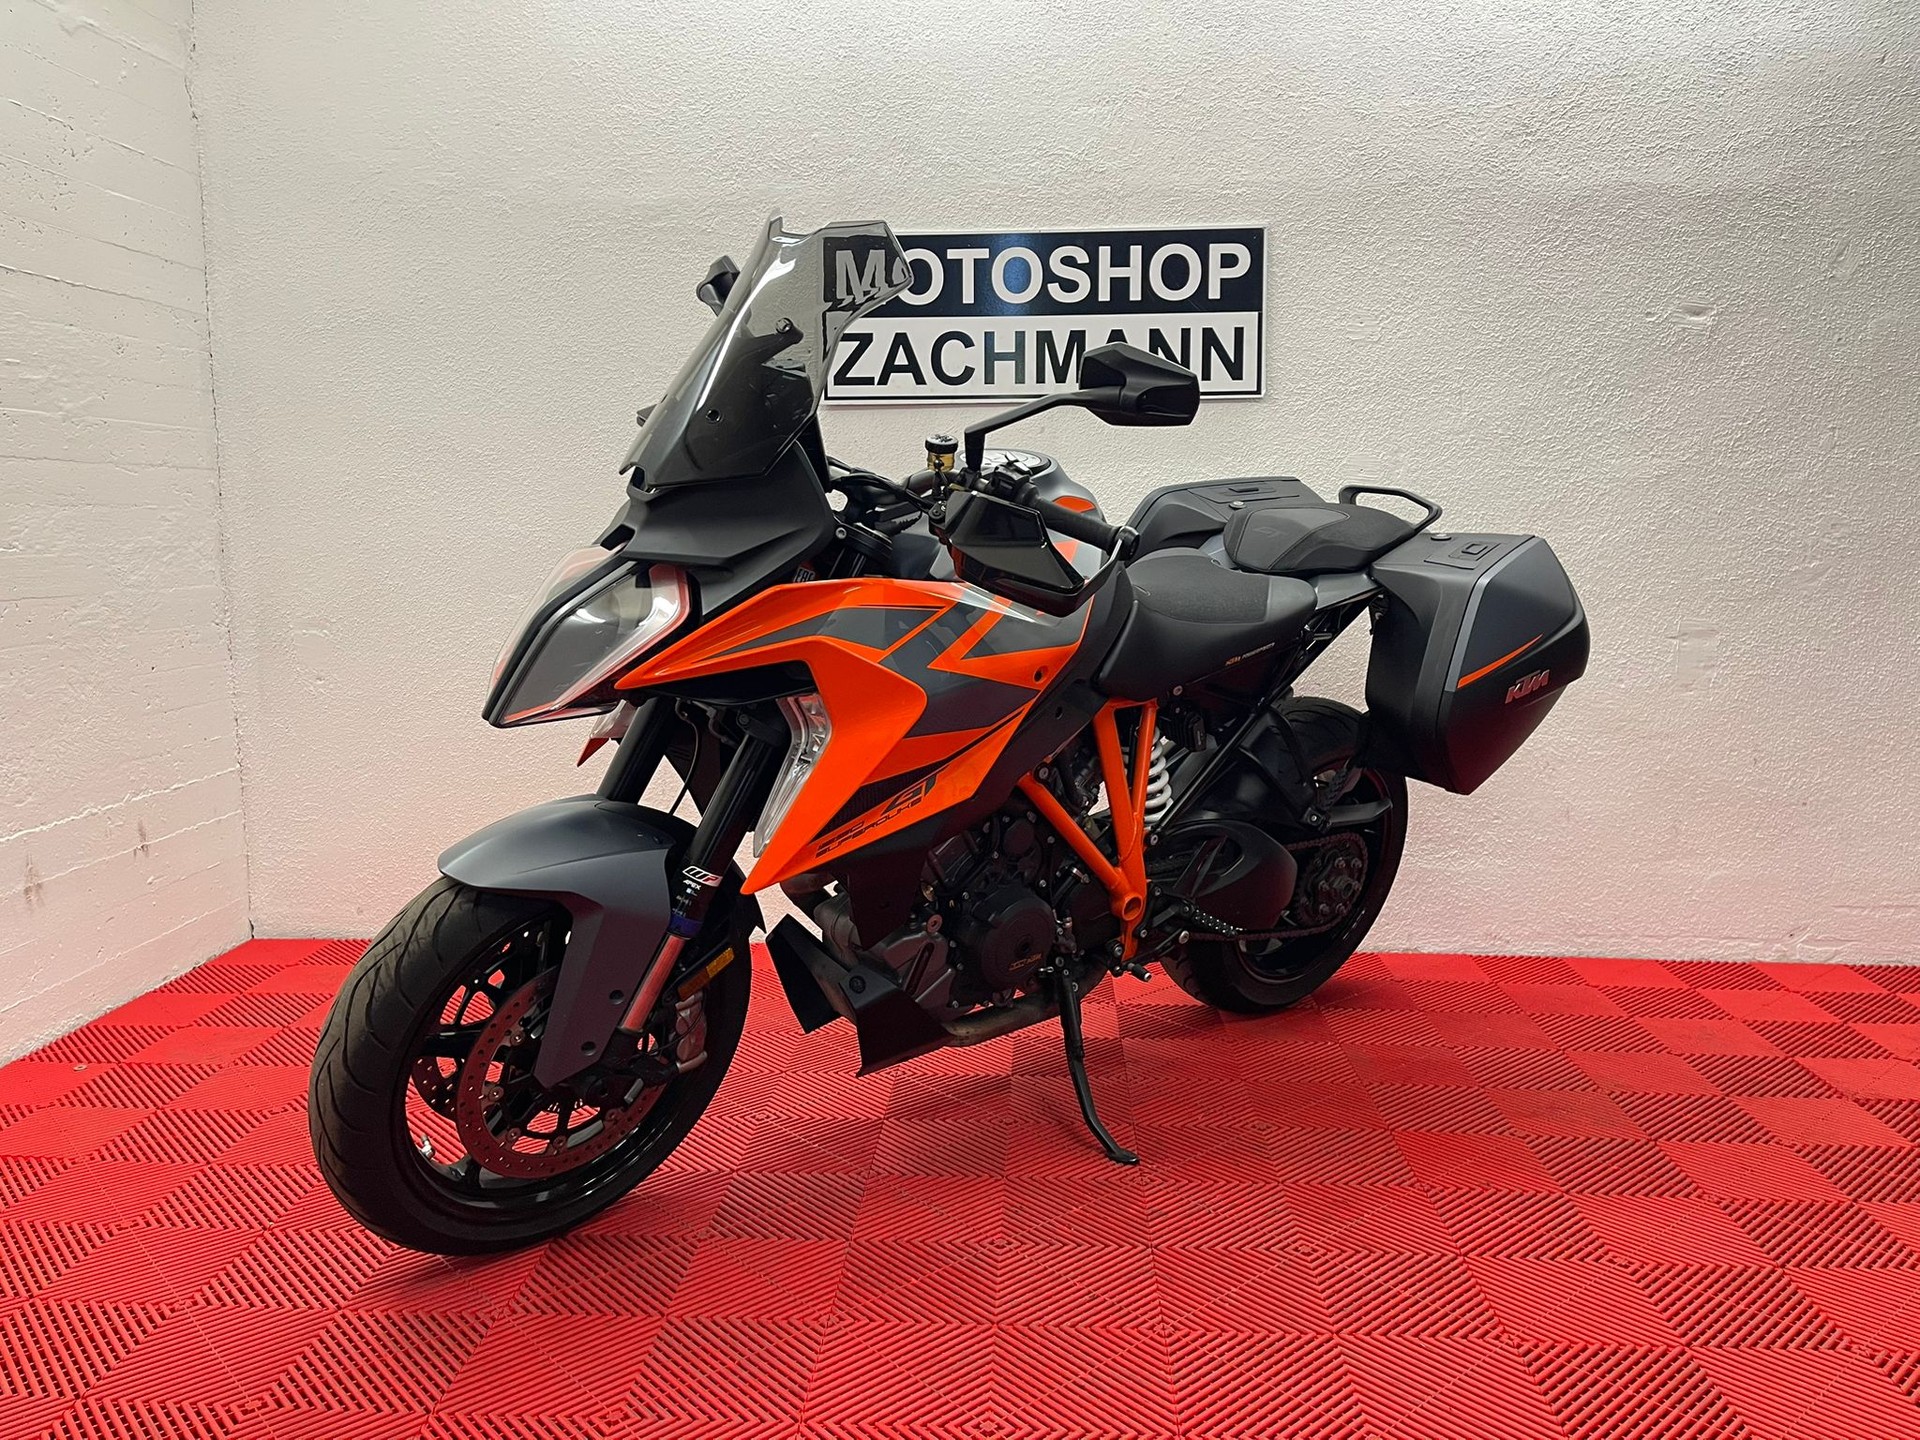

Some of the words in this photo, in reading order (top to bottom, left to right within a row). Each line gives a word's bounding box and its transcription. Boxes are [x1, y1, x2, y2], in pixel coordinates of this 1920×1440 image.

[835, 243, 1252, 305] MOTOSHOP
[832, 327, 1244, 387] ZACHMNN
[1504, 669, 1550, 704] KTM
[683, 879, 702, 890] APEX
